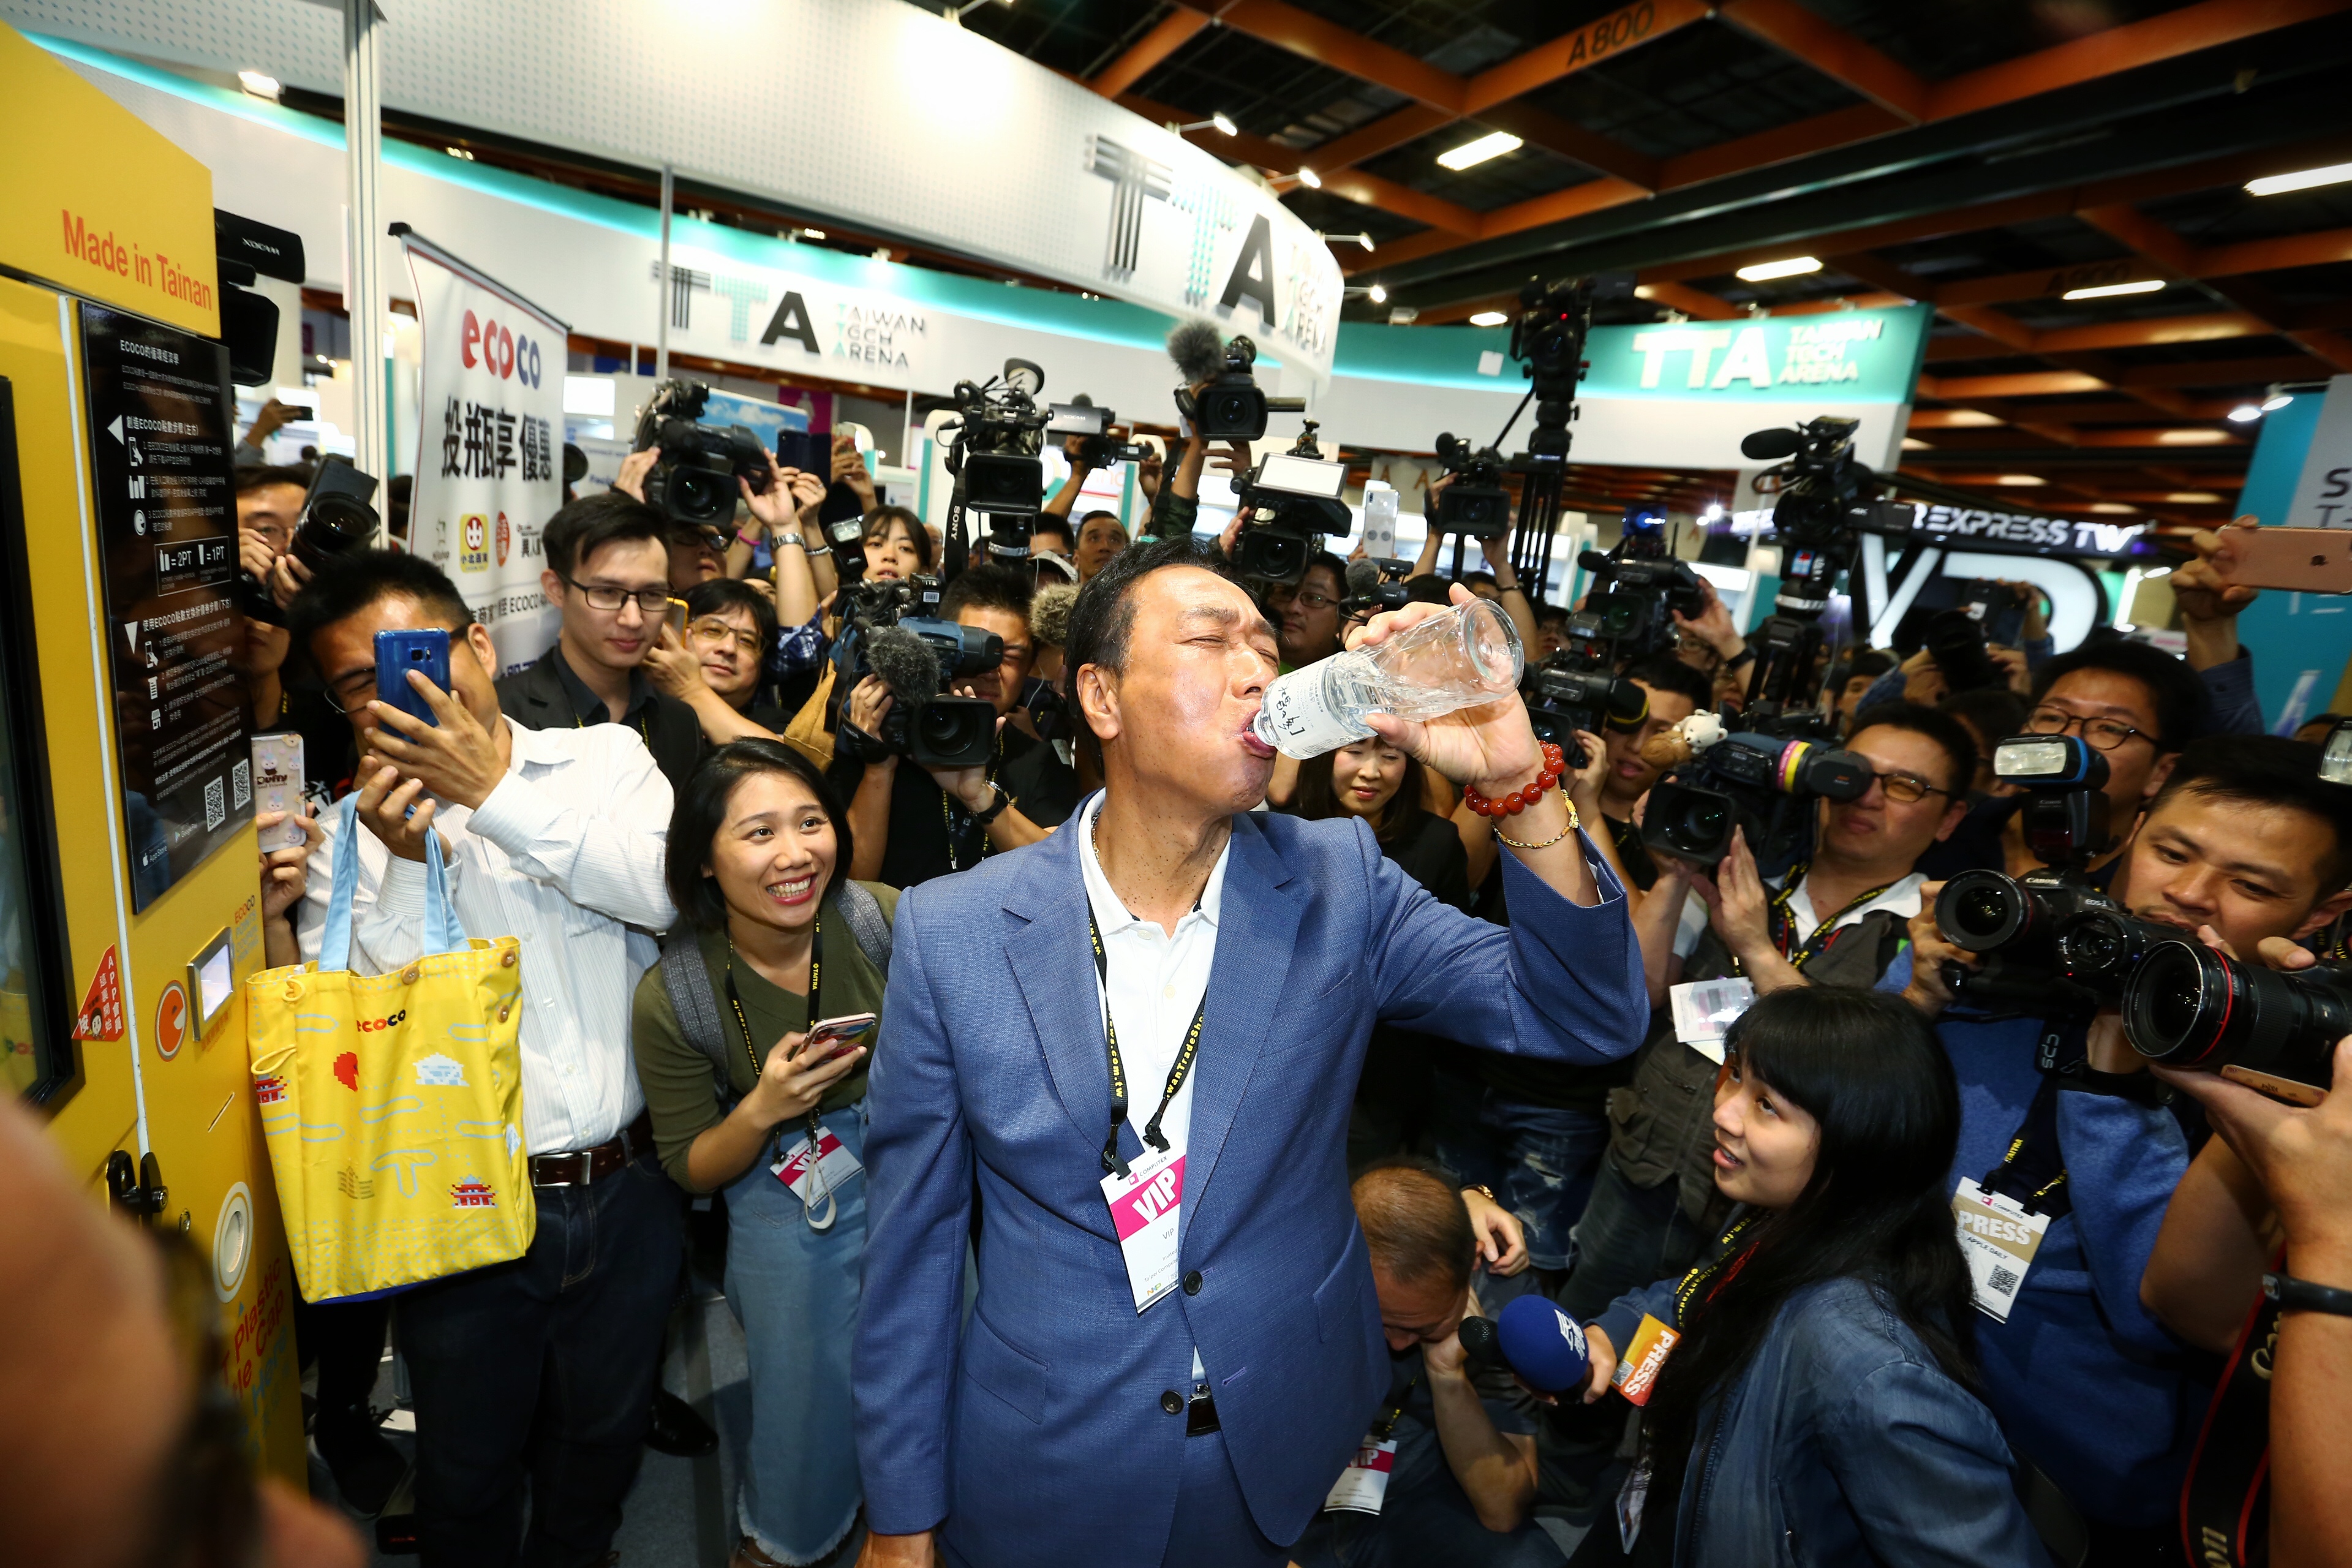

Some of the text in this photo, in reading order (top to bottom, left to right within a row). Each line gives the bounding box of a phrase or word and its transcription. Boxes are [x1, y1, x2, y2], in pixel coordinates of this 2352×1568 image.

[1090, 134, 1276, 329] TTA
[62, 209, 213, 311] Made in Tainan
[652, 260, 821, 356] TTA
[837, 303, 926, 334] TAIWAN
[461, 309, 540, 390] ecoco
[1790, 320, 1883, 344] TAIWAN
[832, 340, 909, 369] ARENA
[1632, 326, 1773, 389] TTA
[1777, 361, 1859, 385] ARENA
[442, 396, 552, 481] 投瓶享優惠
[950, 505, 961, 540] SONY
[1927, 505, 2070, 546] EXPRESS
[1139, 1155, 1168, 1177] COMPUTEX
[1131, 1167, 1177, 1224] VIP
[1162, 1227, 1175, 1240] VIP
[1959, 1210, 2031, 1245] PRESS
[1162, 1248, 1178, 1262] Invited
[1967, 1236, 2008, 1260] APPLE DAILY
[1144, 1270, 1158, 1283] Taipei
[1147, 1283, 1162, 1296] NXP
[234, 1257, 281, 1365] Plastic
[255, 1289, 284, 1357] Cap
[1624, 1330, 1675, 1396] PRESS
